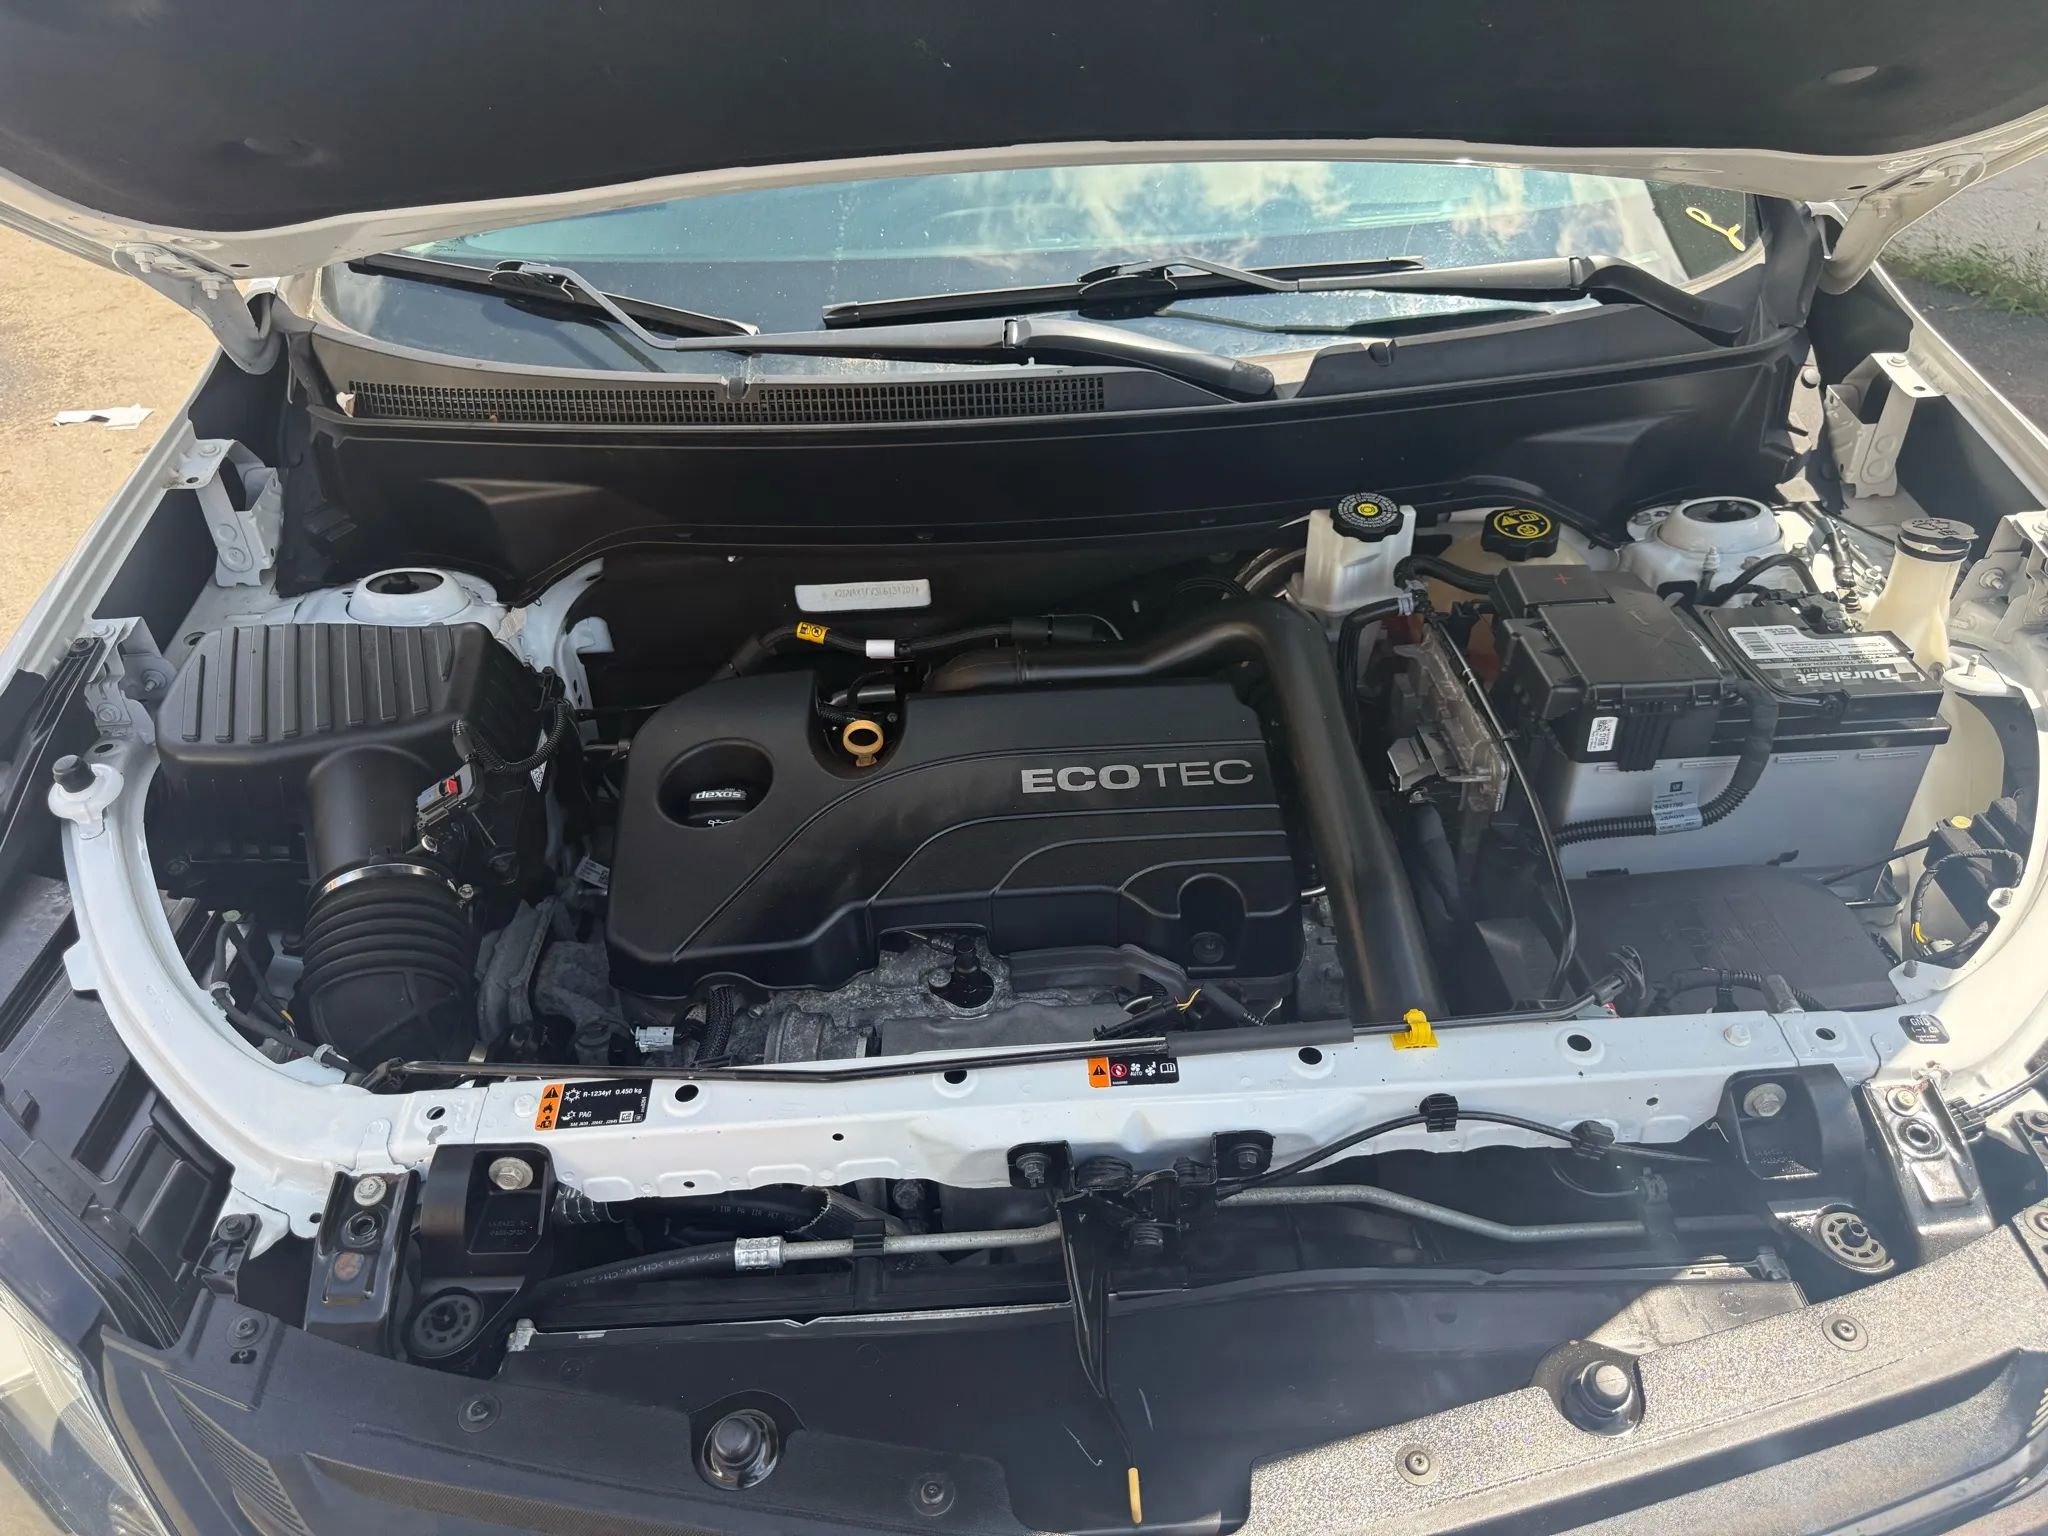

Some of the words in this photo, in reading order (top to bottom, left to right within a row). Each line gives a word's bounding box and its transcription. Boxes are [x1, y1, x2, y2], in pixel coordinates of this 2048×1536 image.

[1796, 669, 1891, 684] Duralast
[1021, 759, 1254, 793] ECOTEC
[695, 790, 741, 800] dexos
[1910, 1017, 1930, 1026] GND
[583, 1089, 612, 1098] R-1234yf
[634, 1087, 643, 1095] kg
